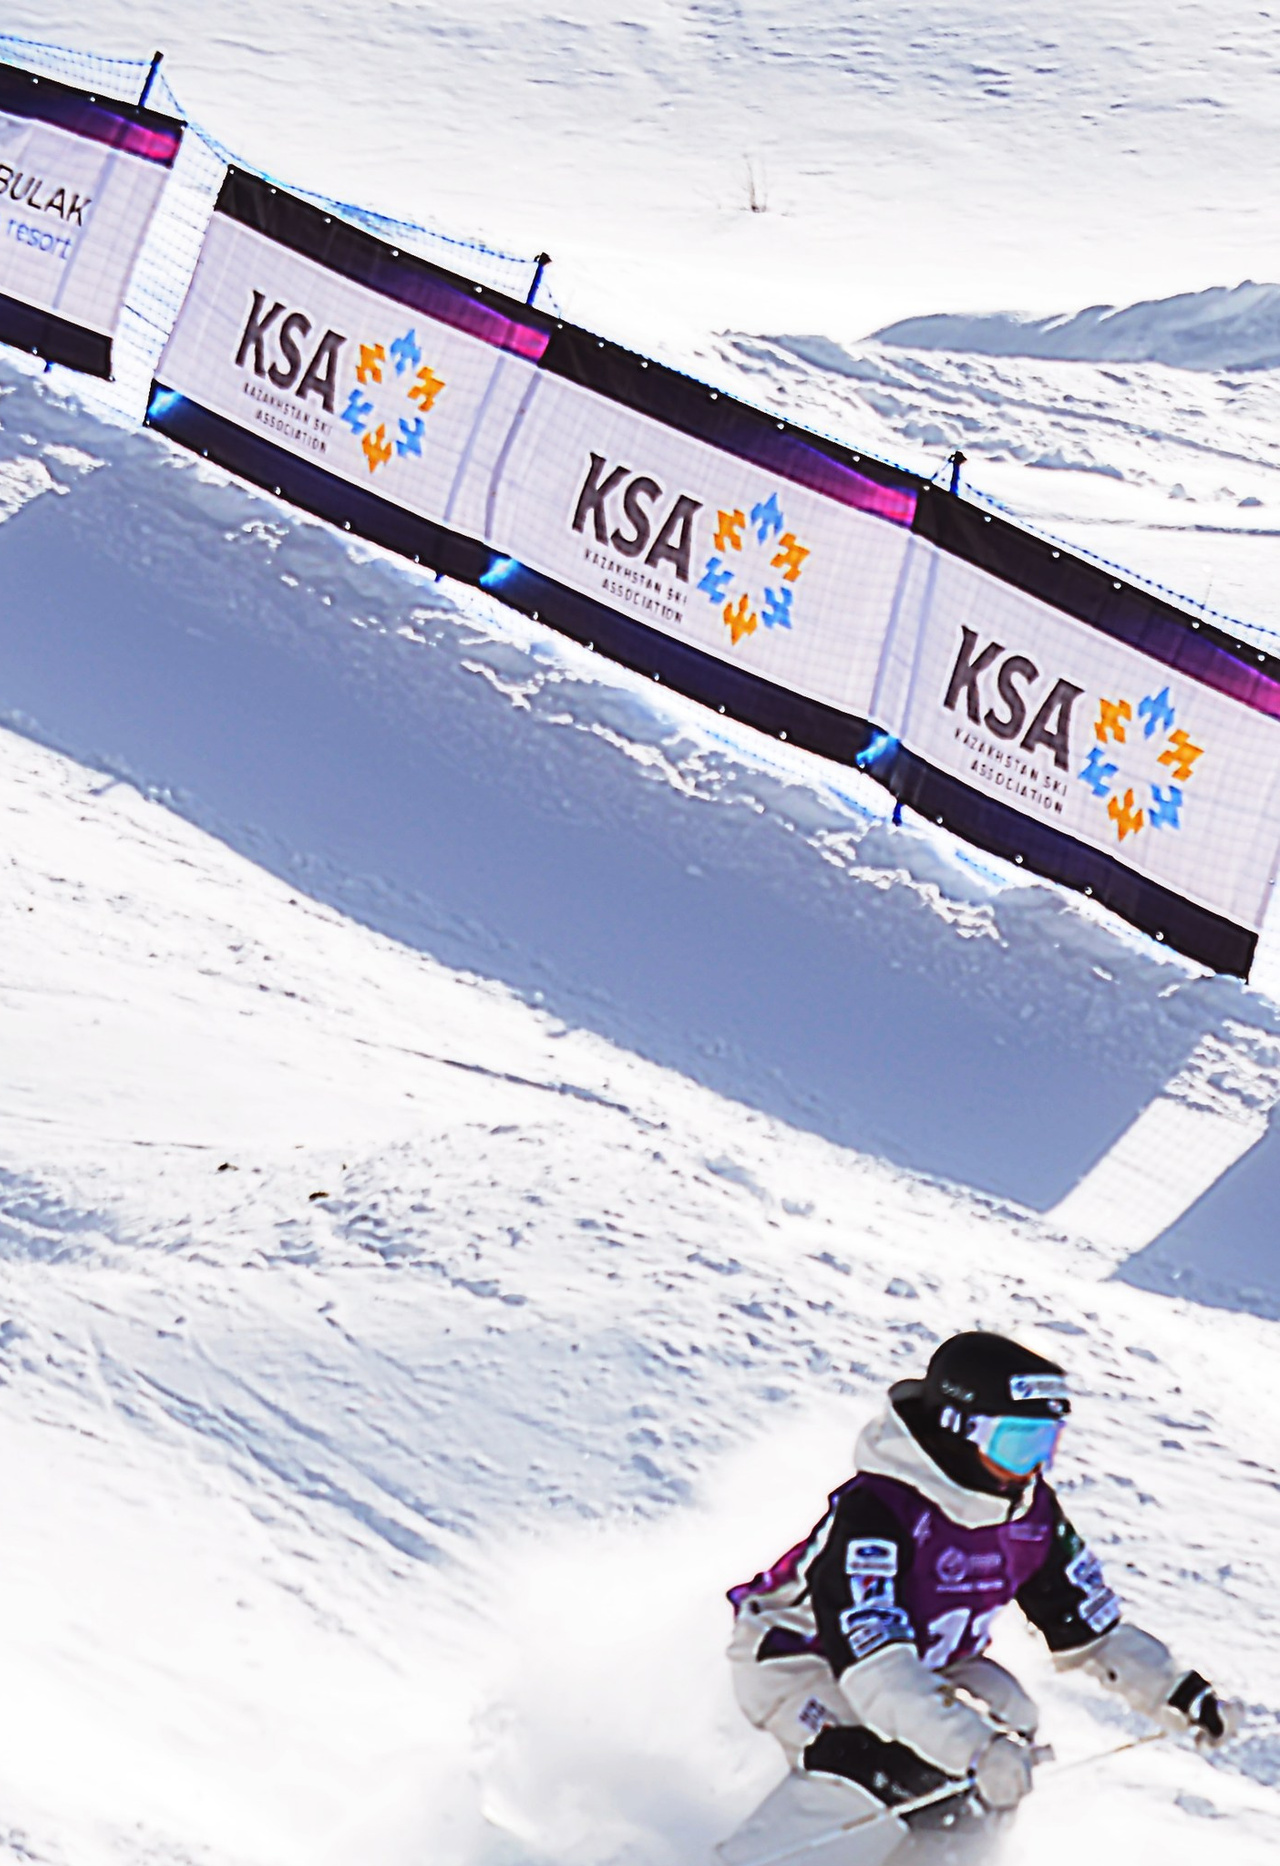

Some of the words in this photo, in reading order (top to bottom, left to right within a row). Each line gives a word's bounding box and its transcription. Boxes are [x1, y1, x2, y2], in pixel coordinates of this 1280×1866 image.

[7, 218, 72, 260] resort
[235, 289, 348, 415] KSA
[244, 382, 310, 424] KAZAKHSTAN
[313, 418, 334, 437] SKI
[256, 410, 327, 453] ASSOCIATION
[572, 451, 703, 583] KSA
[584, 548, 662, 593] KAZAKHSTAN
[668, 588, 688, 606] SKI
[602, 578, 683, 624] ASSOCIATION
[943, 625, 1085, 772] KSA
[954, 728, 1039, 780] KAZAKHSTAN
[1043, 776, 1069, 797] SKI
[971, 760, 1063, 814] ASSOCIATION
